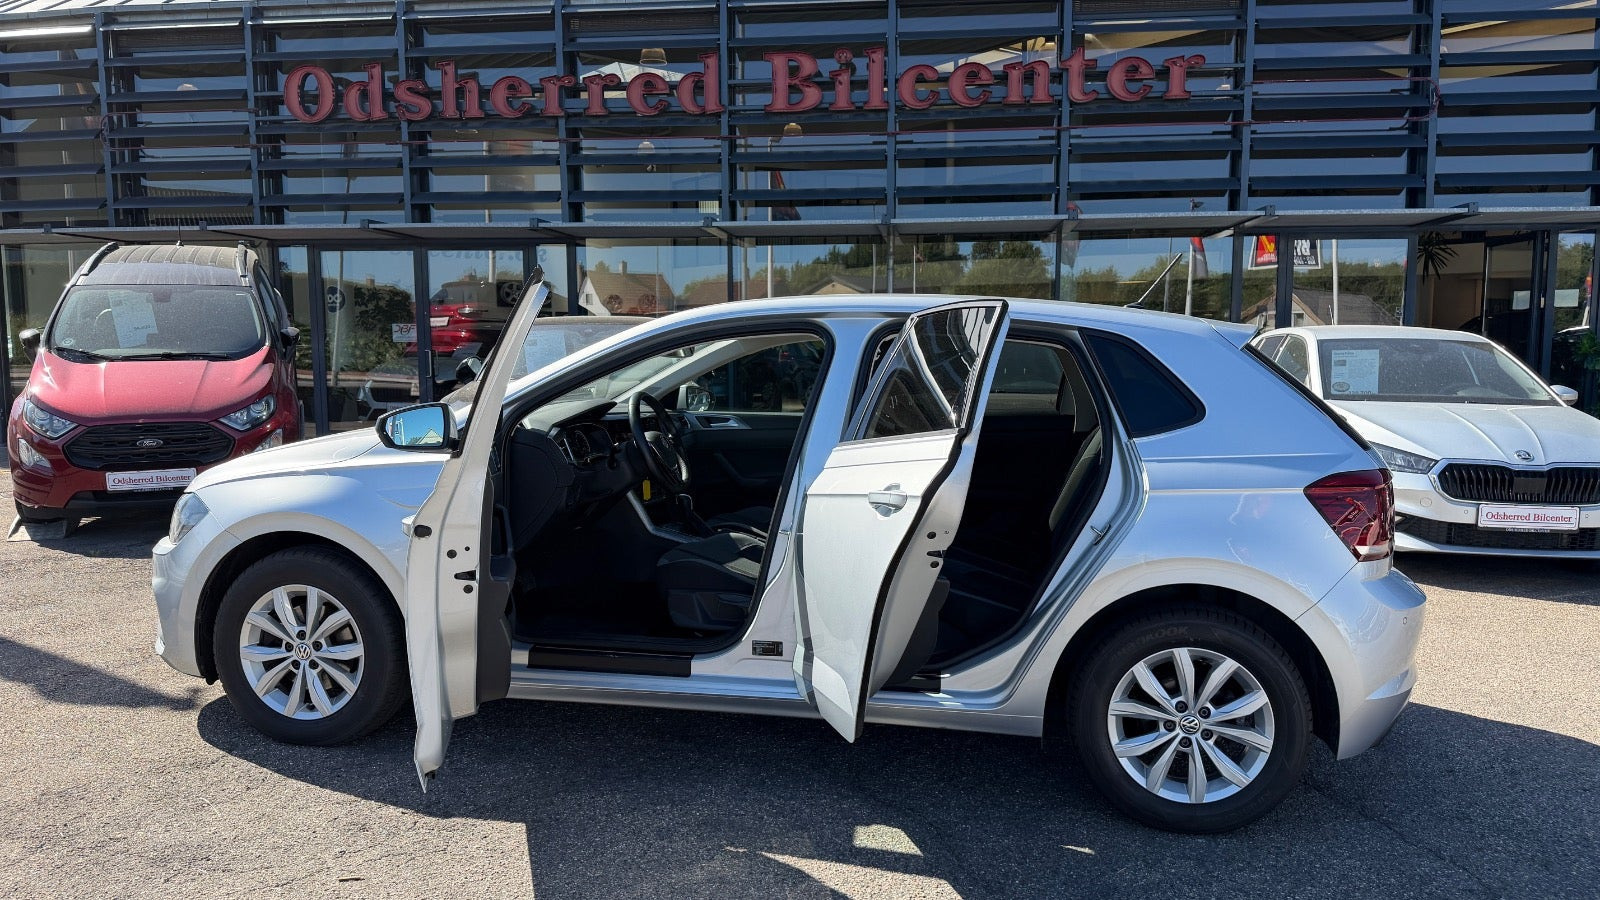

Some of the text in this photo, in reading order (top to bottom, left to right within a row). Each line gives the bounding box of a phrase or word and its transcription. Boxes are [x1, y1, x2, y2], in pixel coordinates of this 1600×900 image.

[284, 46, 1206, 124] Odsherred Bilcenter
[113, 475, 191, 485] Odsherred Bilcenter
[1486, 511, 1573, 522] Odsherred Bilcenter
